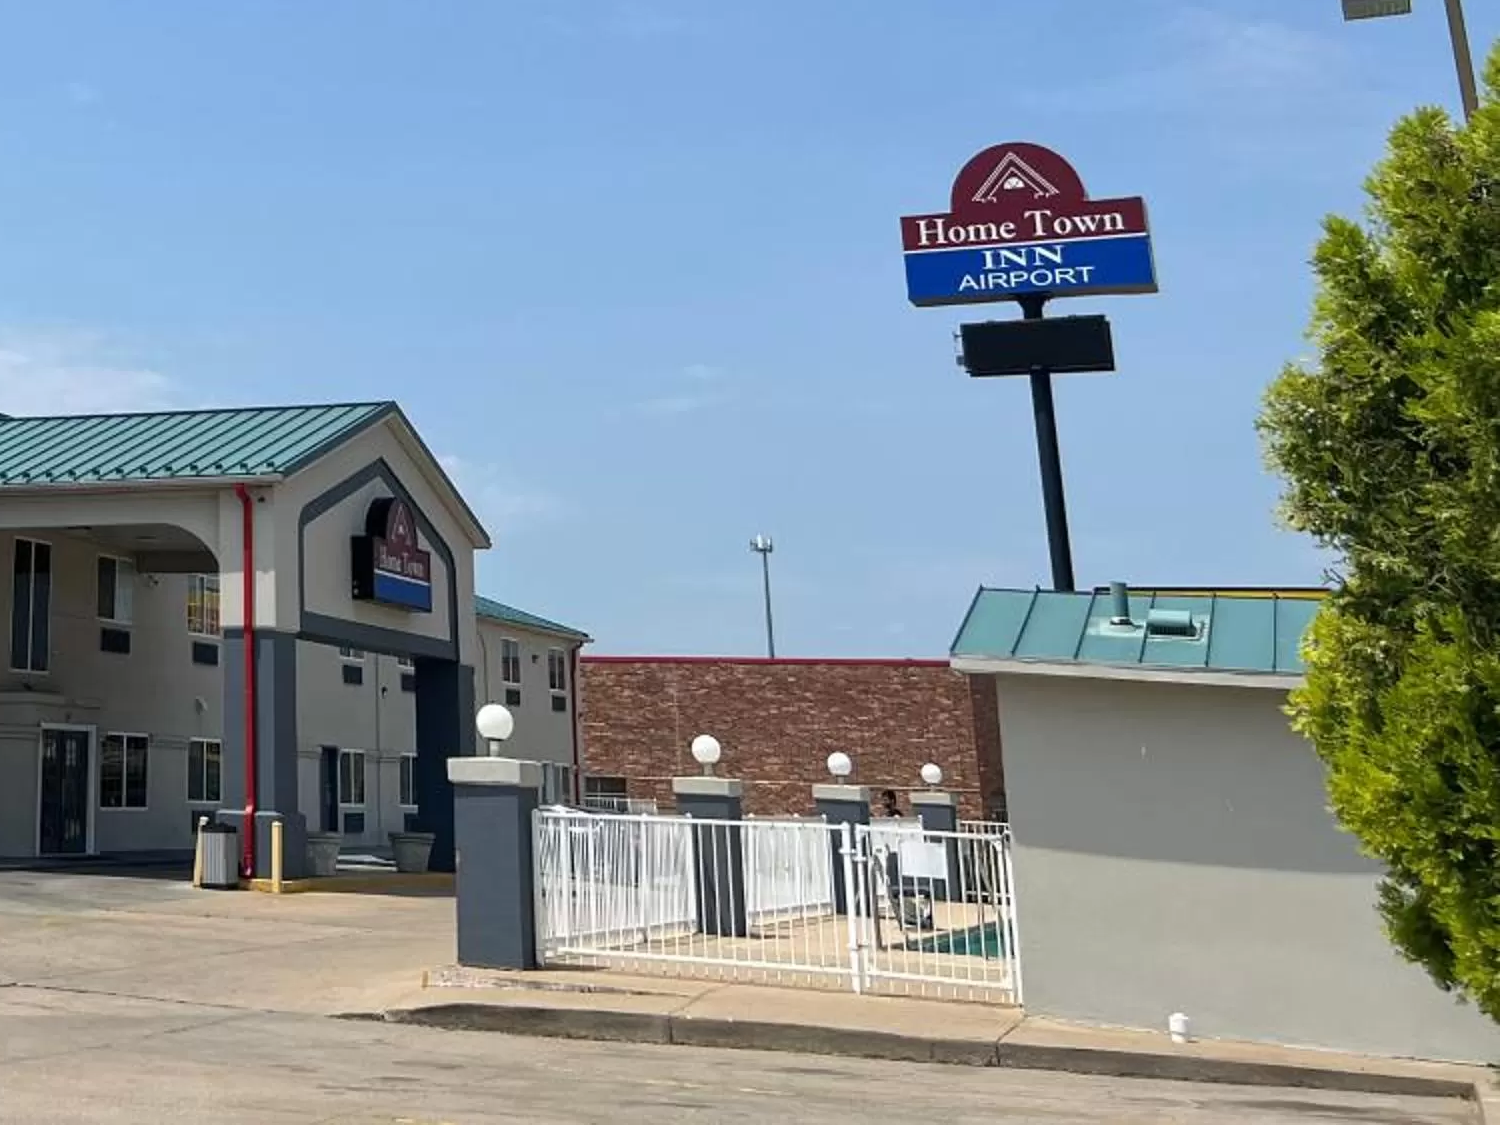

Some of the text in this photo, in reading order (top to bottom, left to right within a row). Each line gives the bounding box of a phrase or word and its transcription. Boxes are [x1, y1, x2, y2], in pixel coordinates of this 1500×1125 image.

[916, 209, 1125, 246] Home Town
[981, 244, 1065, 270] INN
[958, 266, 1095, 291] AIRPORT
